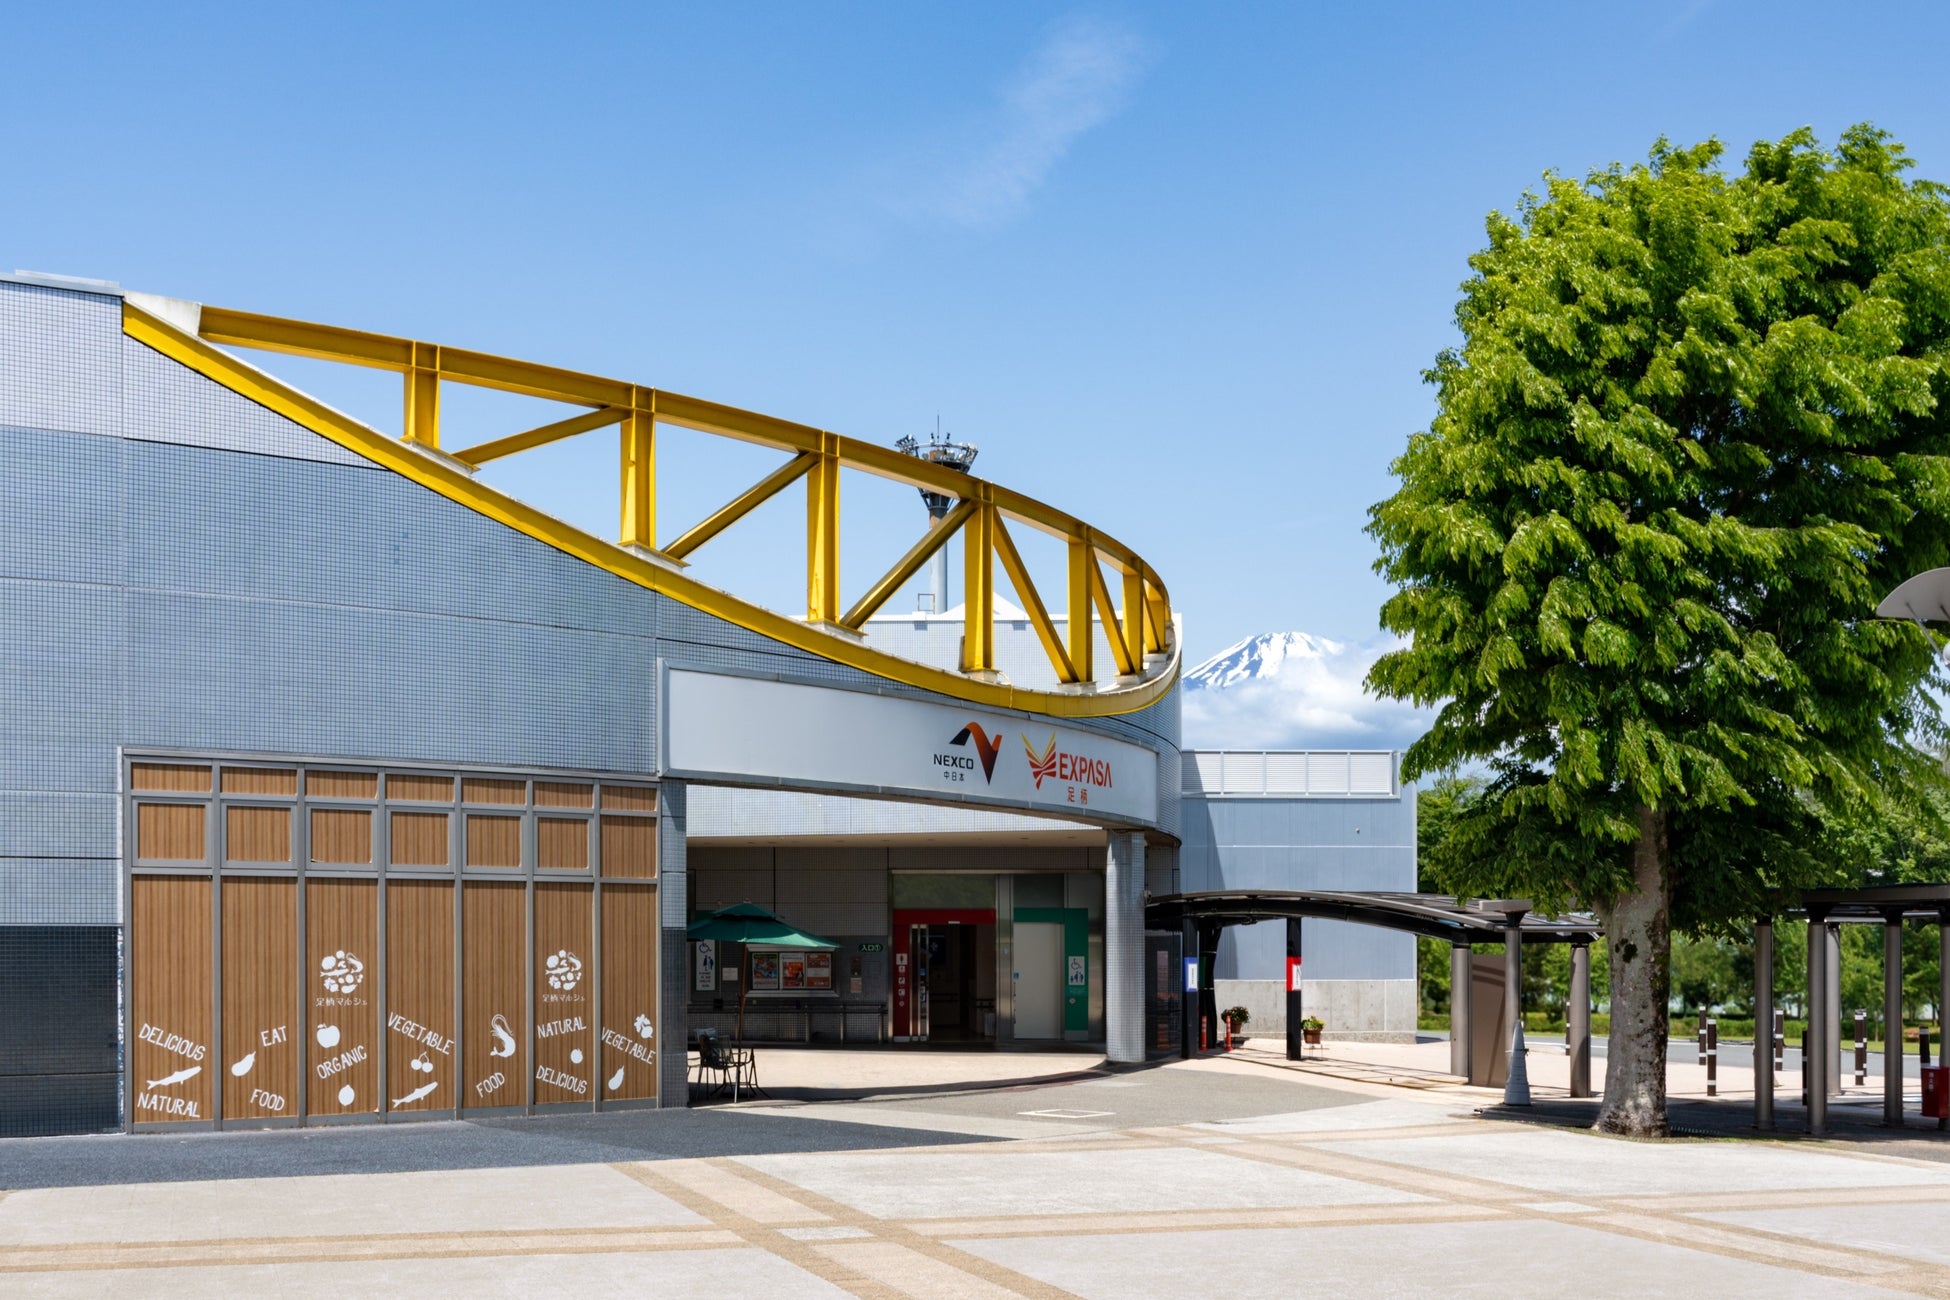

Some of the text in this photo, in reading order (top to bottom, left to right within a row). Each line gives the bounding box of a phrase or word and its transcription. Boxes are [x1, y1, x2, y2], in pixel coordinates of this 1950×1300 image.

[933, 754, 974, 770] NEXCO
[1059, 753, 1113, 788] EXPASA
[943, 771, 965, 782] 中日本
[260, 1025, 288, 1047] EAT
[388, 1012, 455, 1055] VEGETABLE
[537, 1016, 586, 1039] NATURAL
[138, 1023, 206, 1061] DELICIOUS
[601, 1027, 656, 1064] VEGETABLE
[317, 1045, 368, 1079] ORGANIC
[476, 1072, 505, 1098] FOOD
[536, 1065, 587, 1094] DELICIOUS
[137, 1092, 201, 1118] NATURAL
[250, 1088, 285, 1111] FOOD
